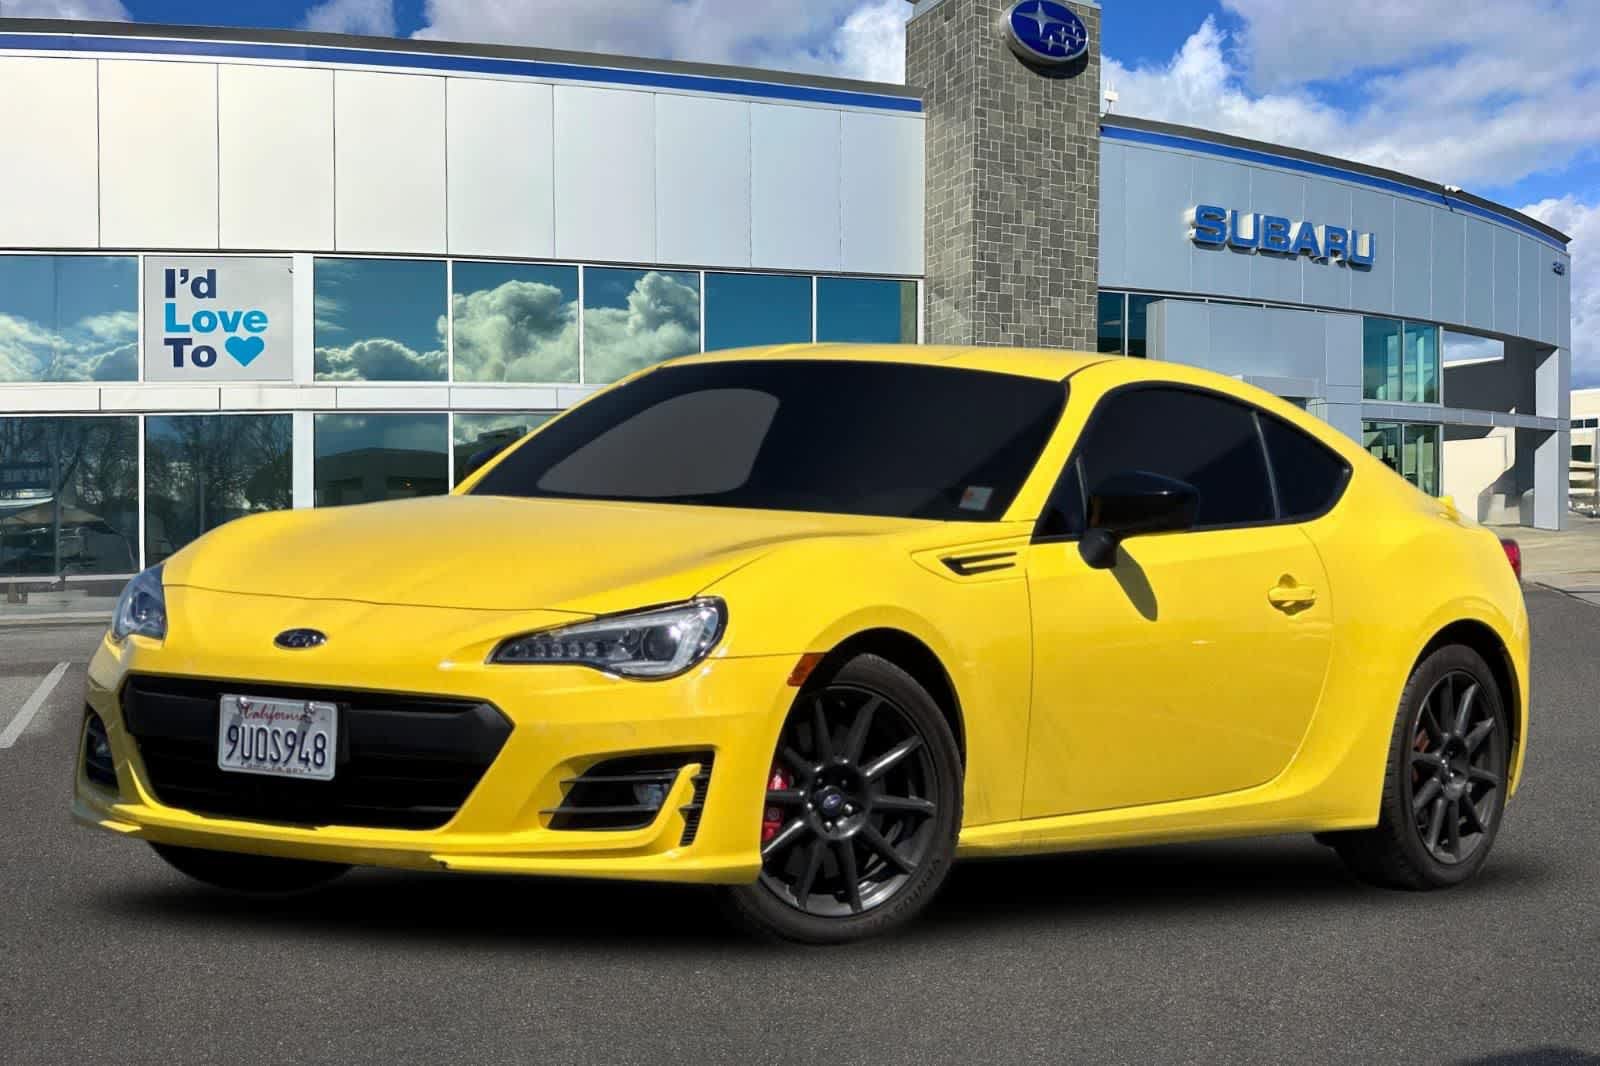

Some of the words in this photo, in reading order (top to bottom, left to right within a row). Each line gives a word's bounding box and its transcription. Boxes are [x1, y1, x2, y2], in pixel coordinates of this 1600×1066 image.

[1192, 204, 1376, 271] SUBARU
[165, 268, 217, 299] I’d
[165, 302, 268, 333] Love
[164, 337, 217, 368] To
